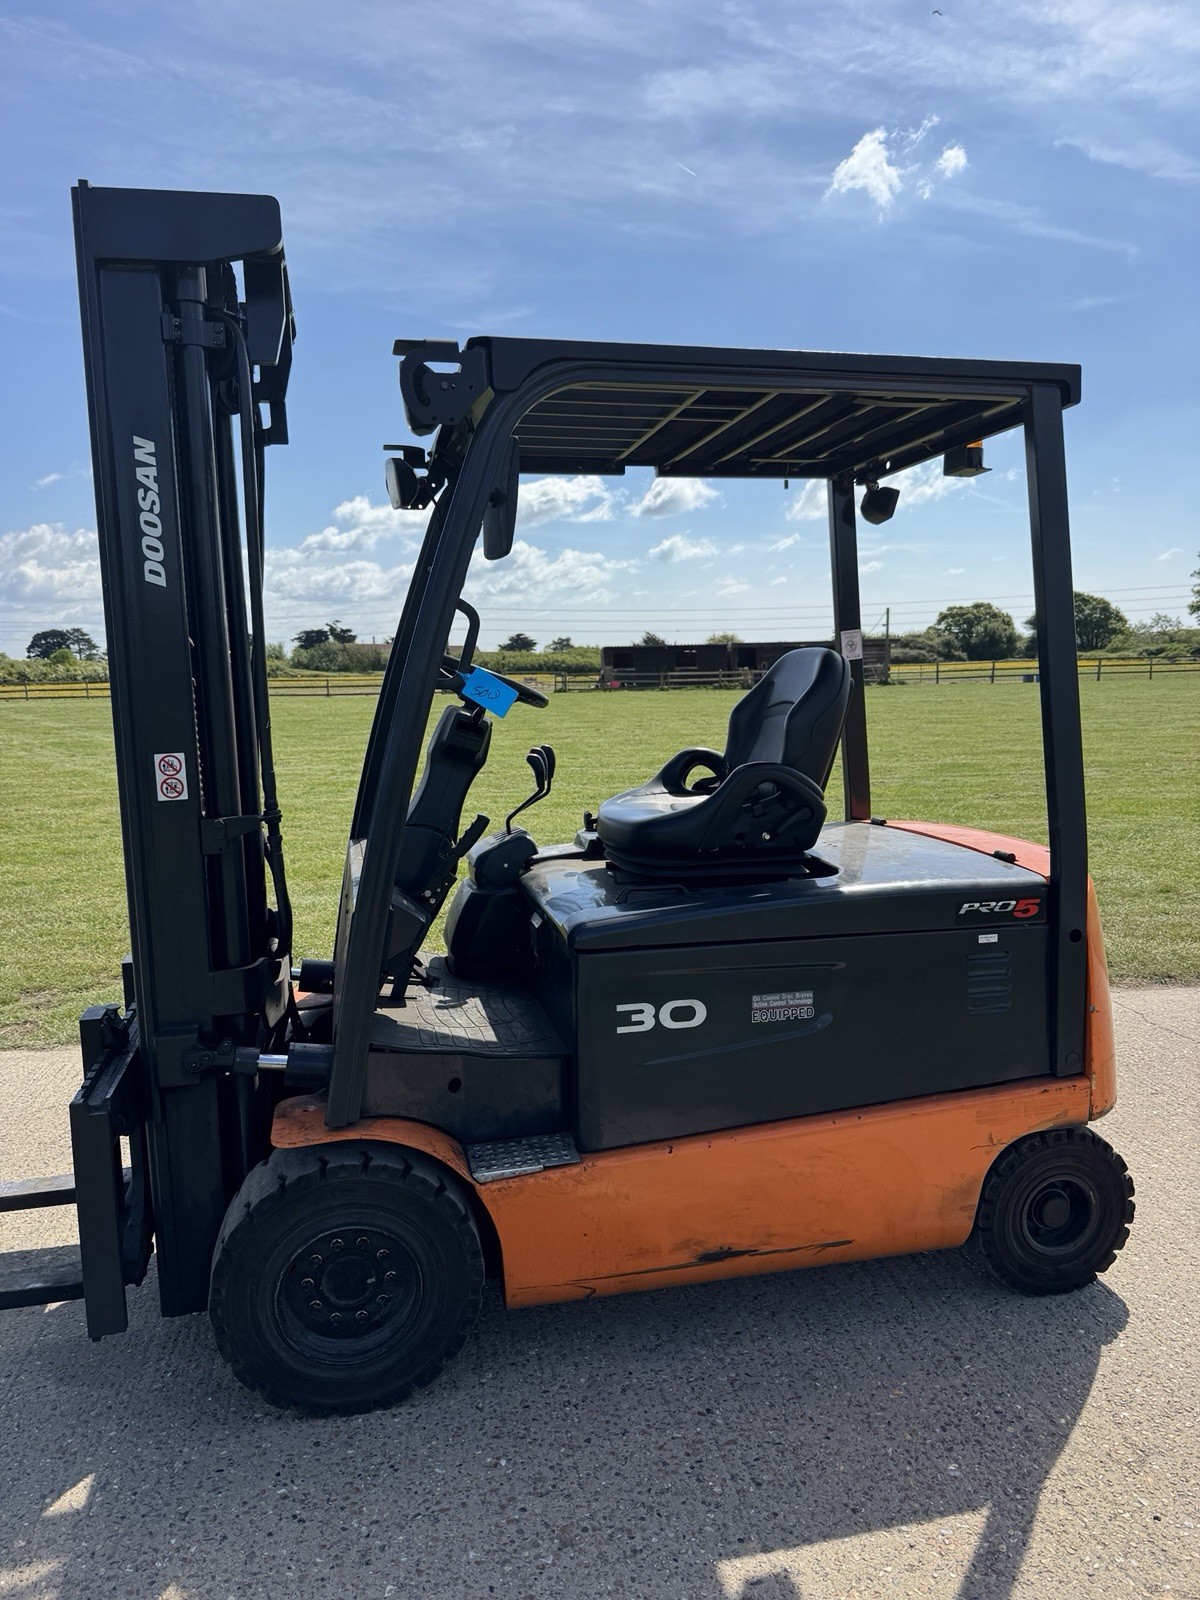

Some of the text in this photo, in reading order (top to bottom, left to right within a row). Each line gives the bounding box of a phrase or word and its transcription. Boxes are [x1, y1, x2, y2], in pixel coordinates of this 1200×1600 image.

[132, 435, 167, 588] DOOSAN
[616, 999, 707, 1034] 30
[752, 1006, 814, 1022] EQUIPPED
